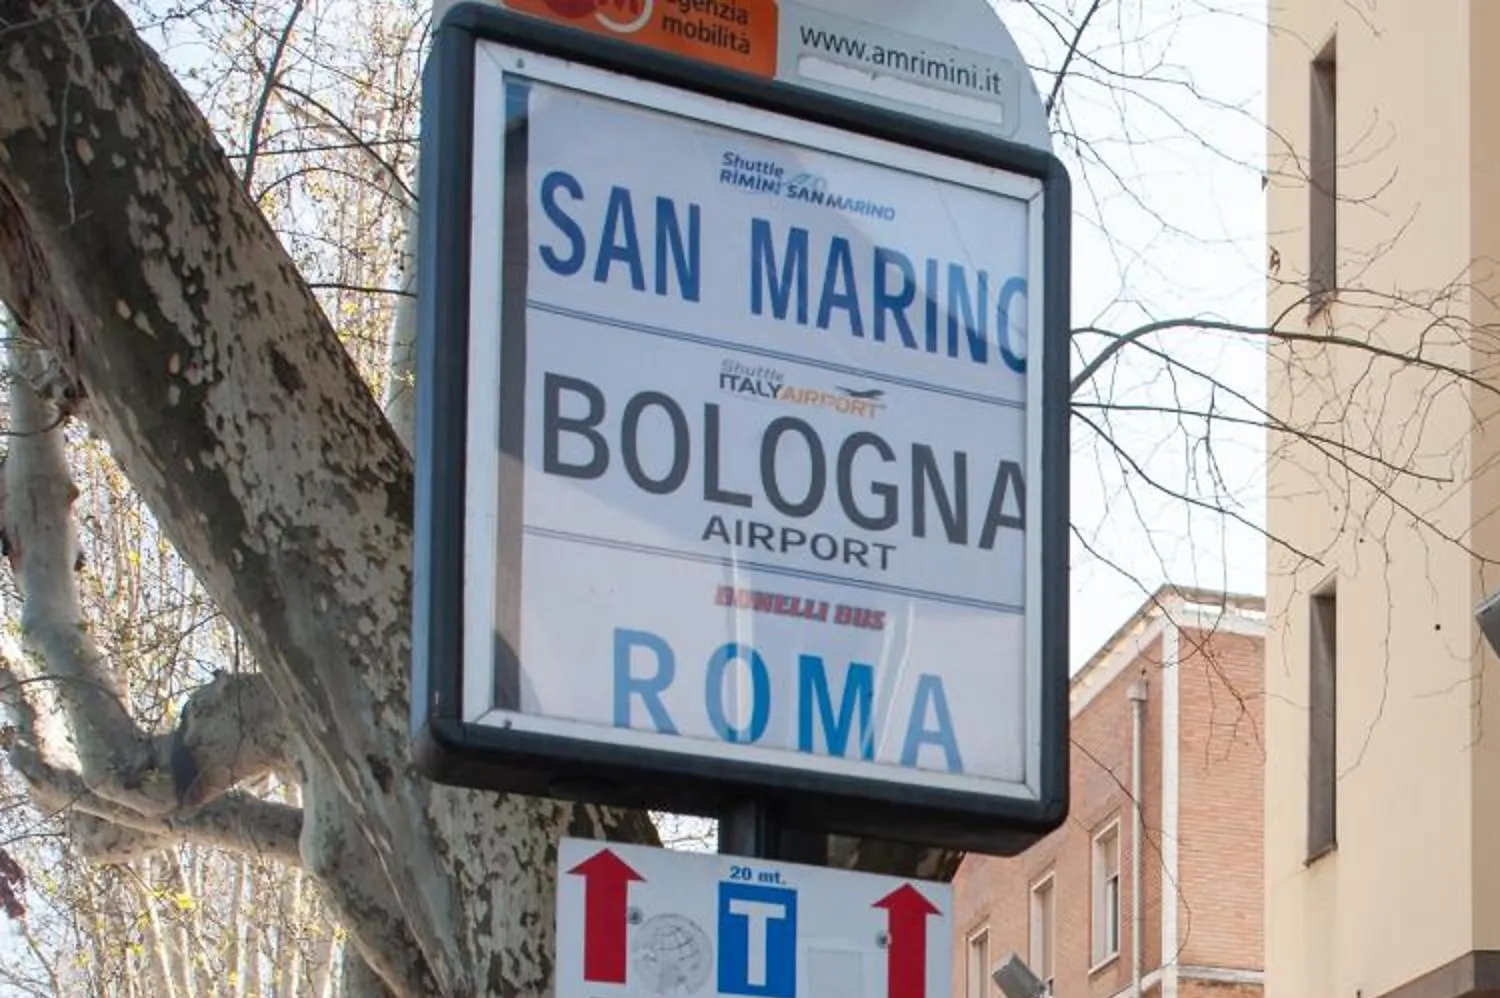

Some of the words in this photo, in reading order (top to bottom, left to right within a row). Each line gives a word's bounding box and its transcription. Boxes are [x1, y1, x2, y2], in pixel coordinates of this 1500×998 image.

[661, 16, 751, 55] mobilità
[665, 0, 748, 25] genzia
[799, 25, 1001, 95] www.amrimini.it
[722, 151, 785, 178] Shuttle
[538, 170, 700, 303] SAN
[720, 358, 785, 383] Shuttle
[541, 371, 1027, 550] BOLOGNA
[701, 514, 897, 571] AIRPORT
[612, 627, 963, 774] ROMA
[729, 865, 752, 880] 20
[757, 870, 787, 885] mt.
[729, 898, 786, 987] T
